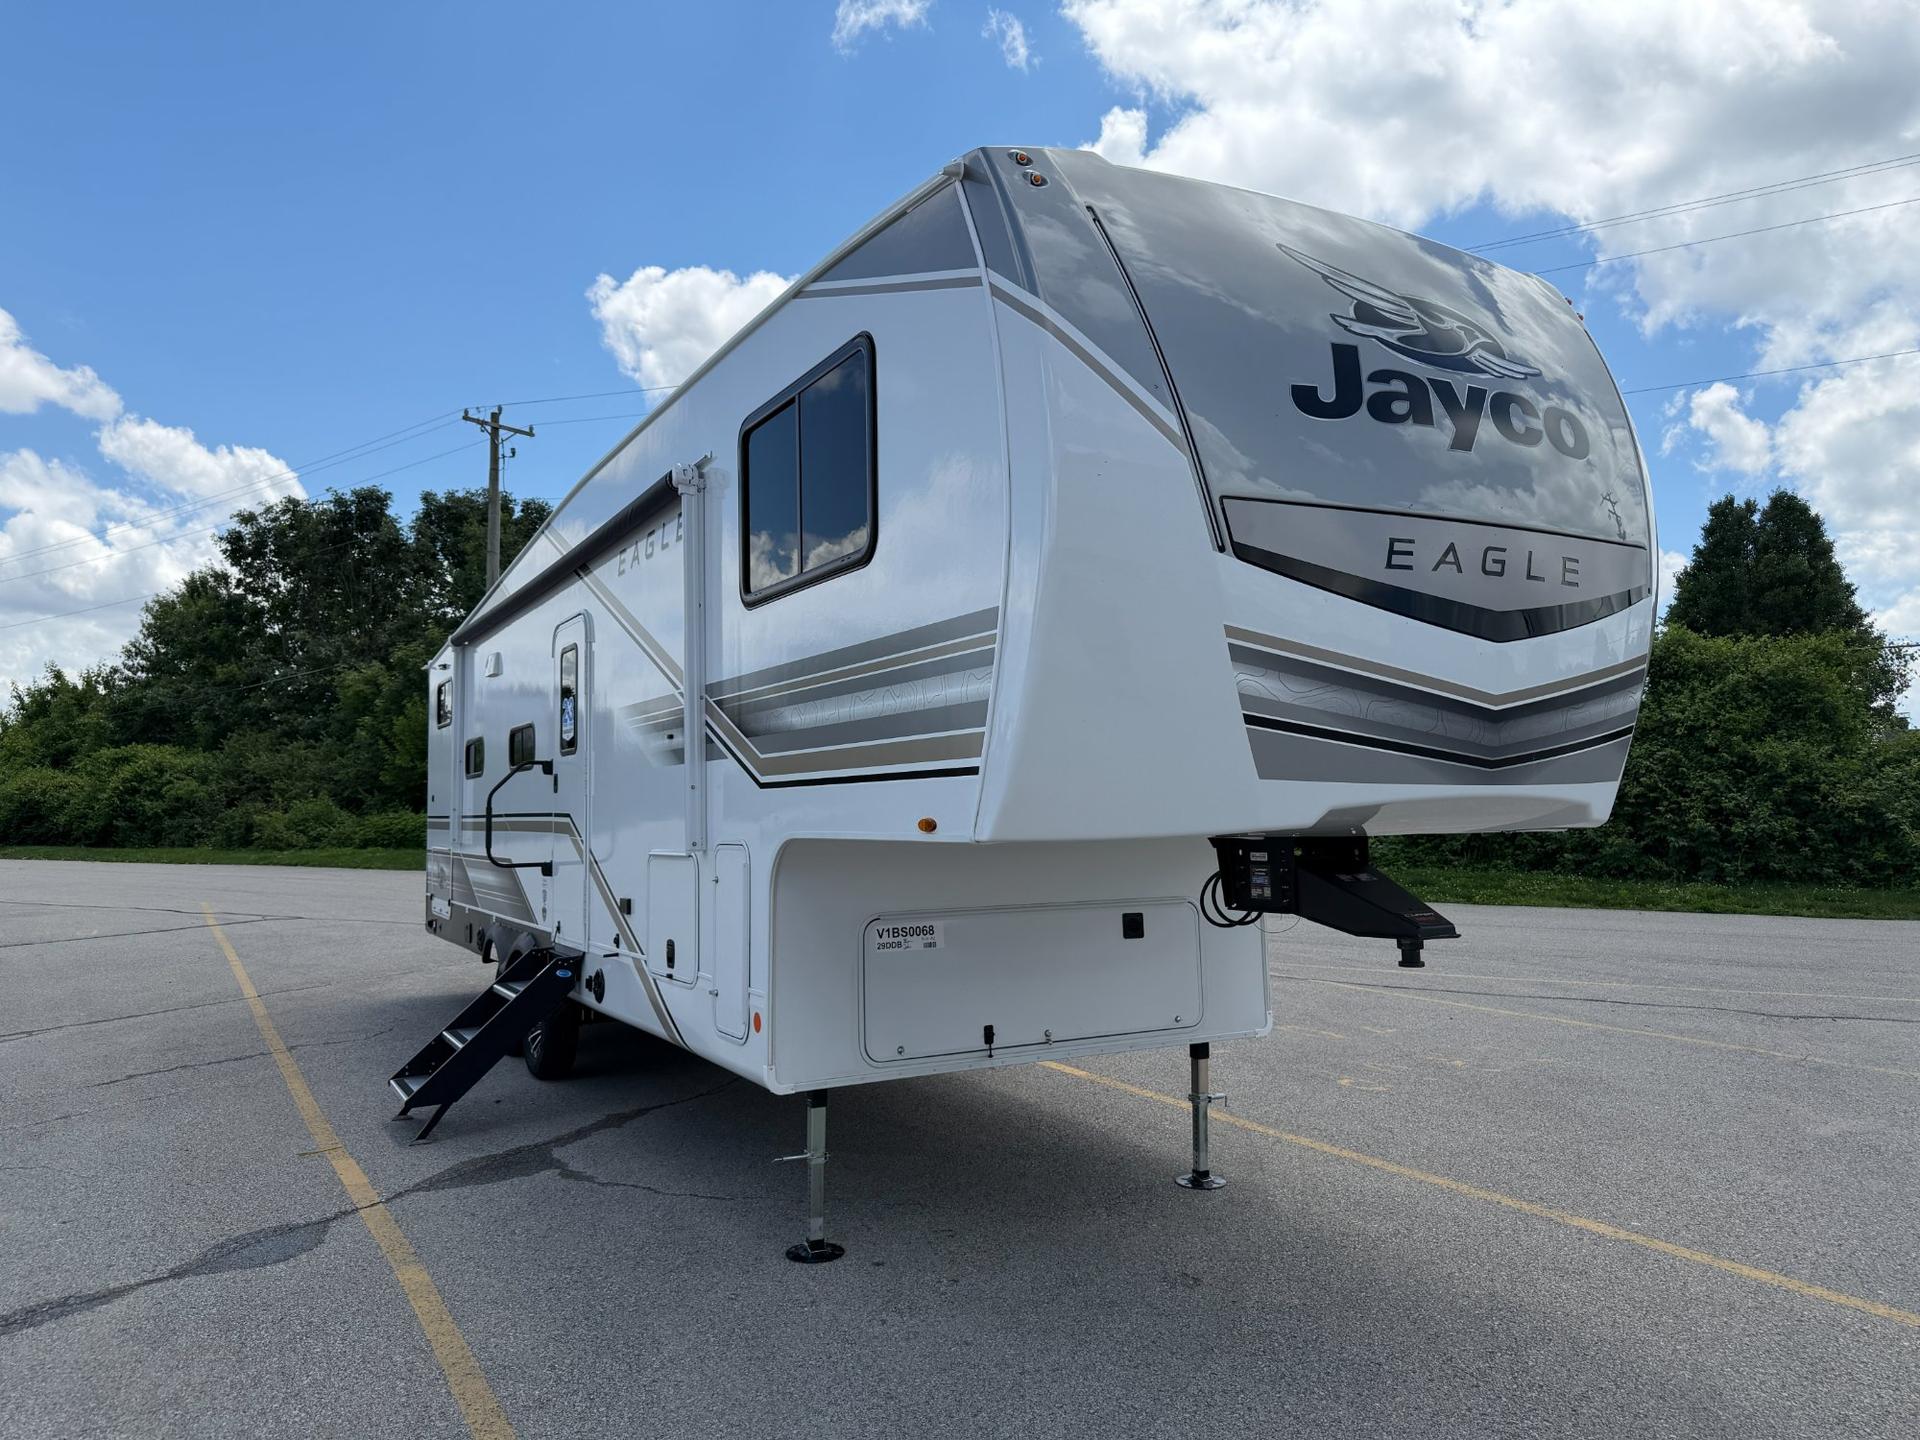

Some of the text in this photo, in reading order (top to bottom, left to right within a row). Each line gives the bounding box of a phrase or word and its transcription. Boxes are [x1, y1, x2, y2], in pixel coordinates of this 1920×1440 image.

[1290, 342, 1589, 460] Jayco
[617, 512, 682, 576] EAGLE
[1385, 537, 1580, 587] EAGLE
[876, 925, 934, 939] V1BS0068
